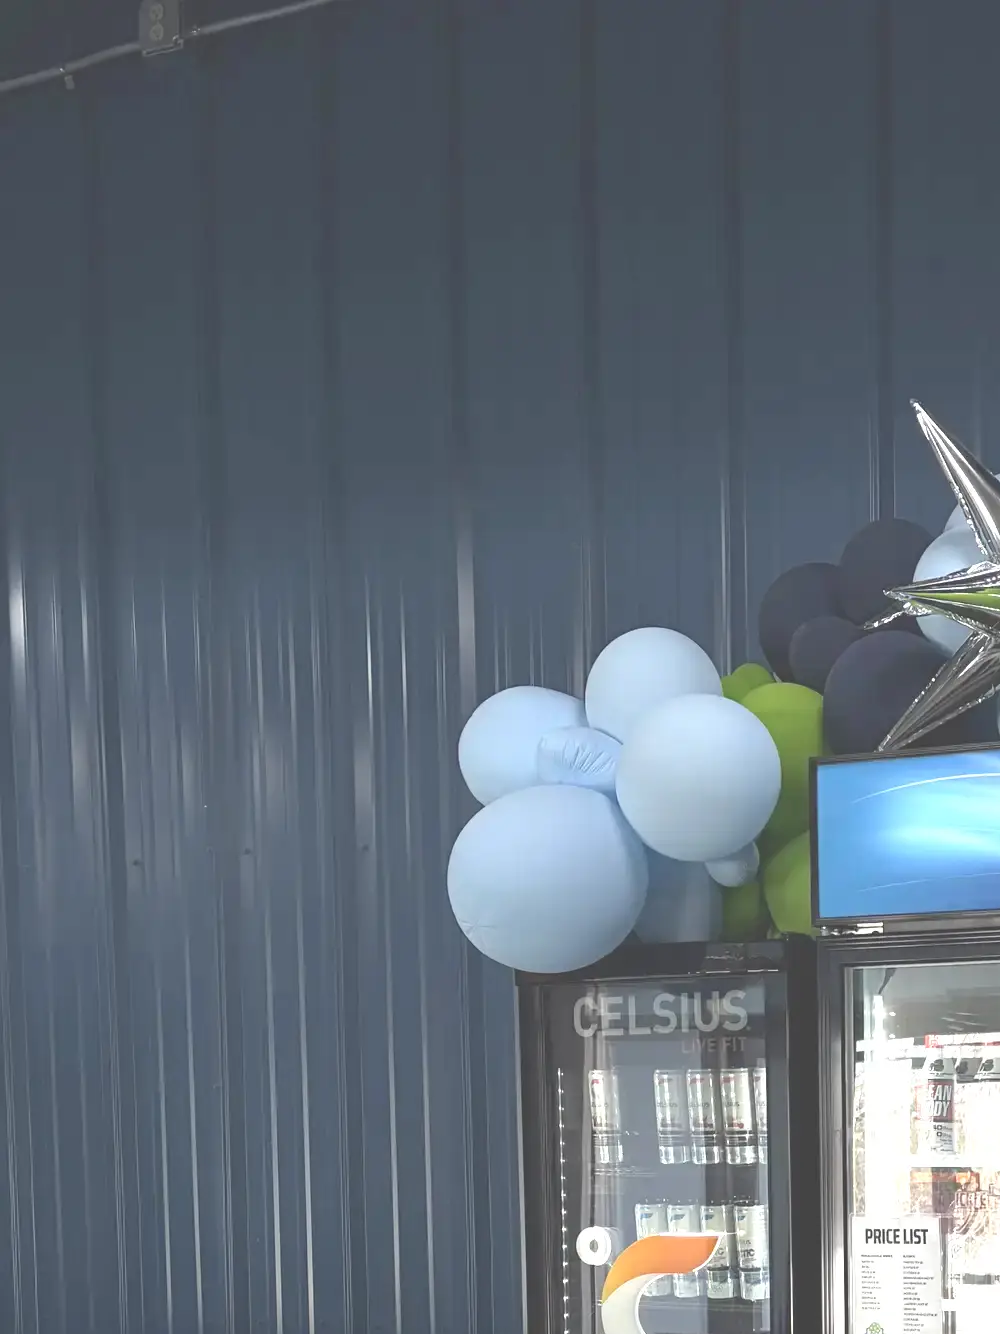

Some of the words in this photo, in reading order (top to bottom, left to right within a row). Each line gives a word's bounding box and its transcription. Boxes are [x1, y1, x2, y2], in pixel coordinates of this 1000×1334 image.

[574, 990, 748, 1038] CELSIUS
[682, 1038, 719, 1053] LIVE
[723, 1036, 747, 1052] FIT
[865, 1228, 900, 1245] PRICE
[903, 1228, 928, 1245] LIST
